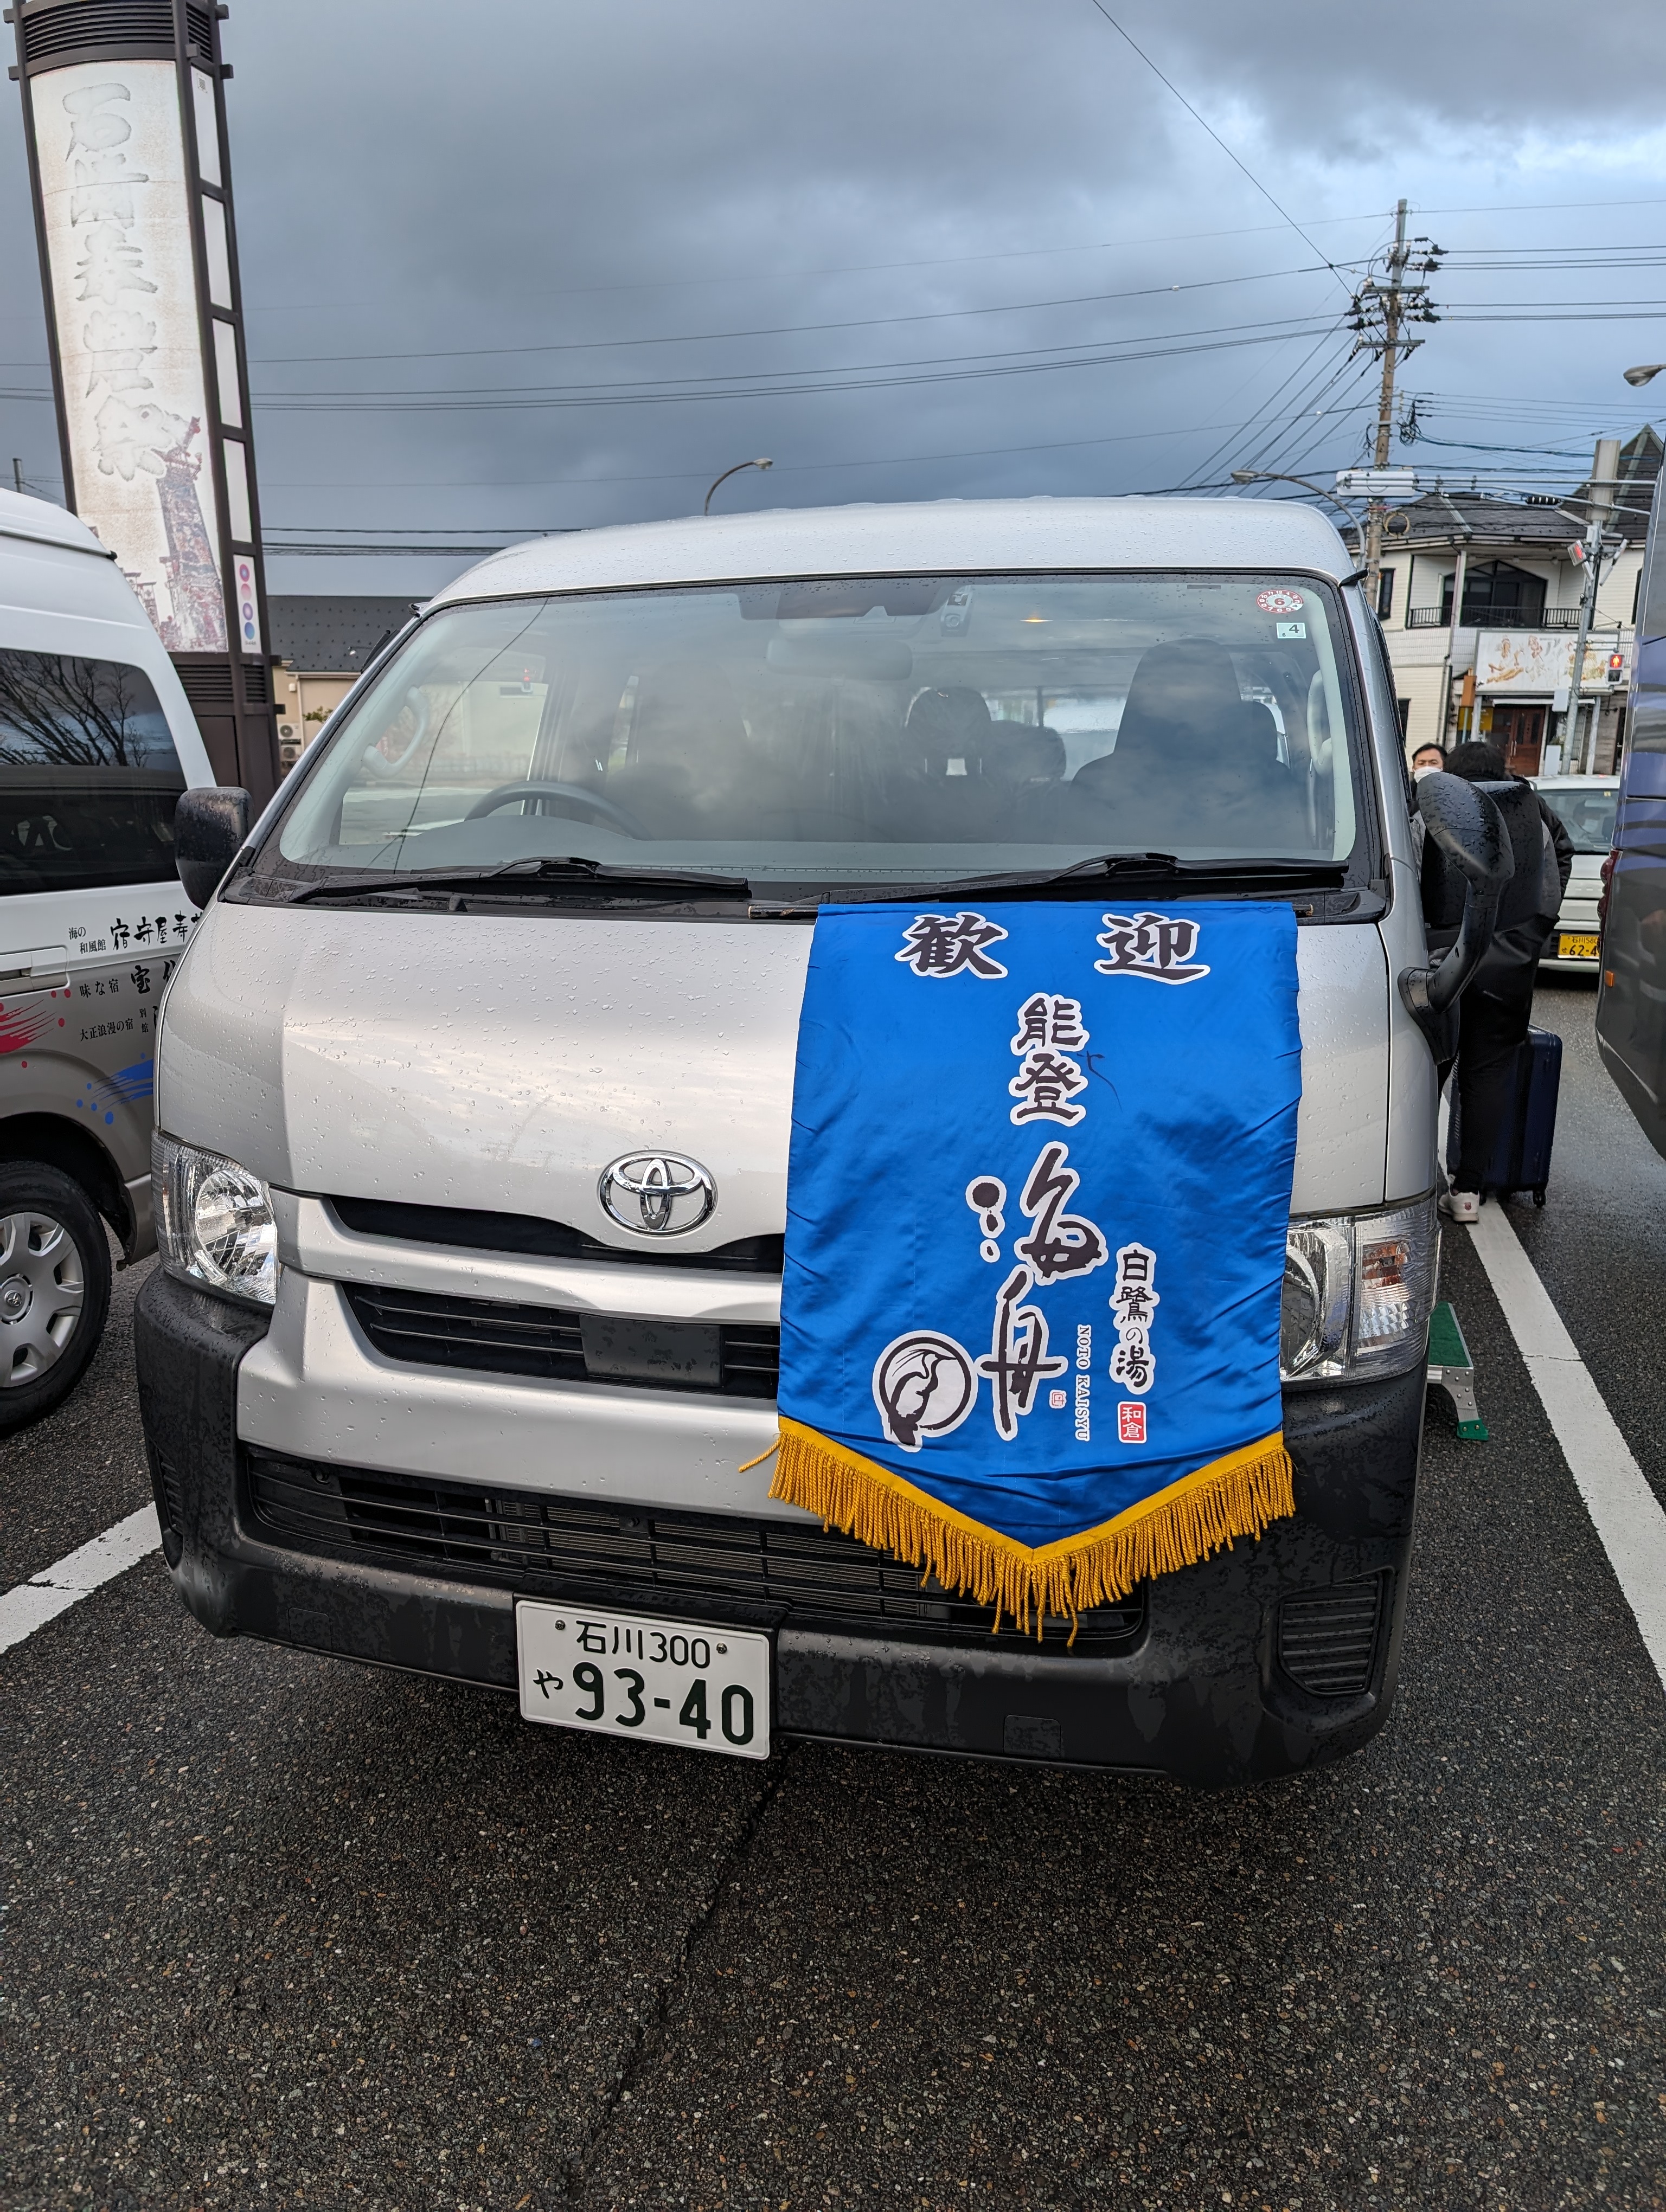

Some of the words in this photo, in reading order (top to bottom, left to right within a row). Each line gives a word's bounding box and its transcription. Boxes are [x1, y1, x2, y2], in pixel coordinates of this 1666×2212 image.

[1289, 624, 1299, 633] 4
[68, 926, 86, 940] 海の
[79, 938, 106, 954] 和風館
[79, 979, 119, 998] 味な宿
[79, 1018, 133, 1041] 大正浪漫の宿
[139, 1008, 149, 1033] 別館
[1012, 995, 1086, 1123] 能登
[1113, 1247, 1155, 1389] 白鷺の湯
[1077, 1326, 1090, 1368] NOTO
[1076, 1376, 1088, 1440] KAISYU
[1121, 1406, 1143, 1438] 和倉
[575, 1619, 710, 1669] 石川300
[533, 1668, 564, 1699] や
[572, 1662, 754, 1746] 93-40
